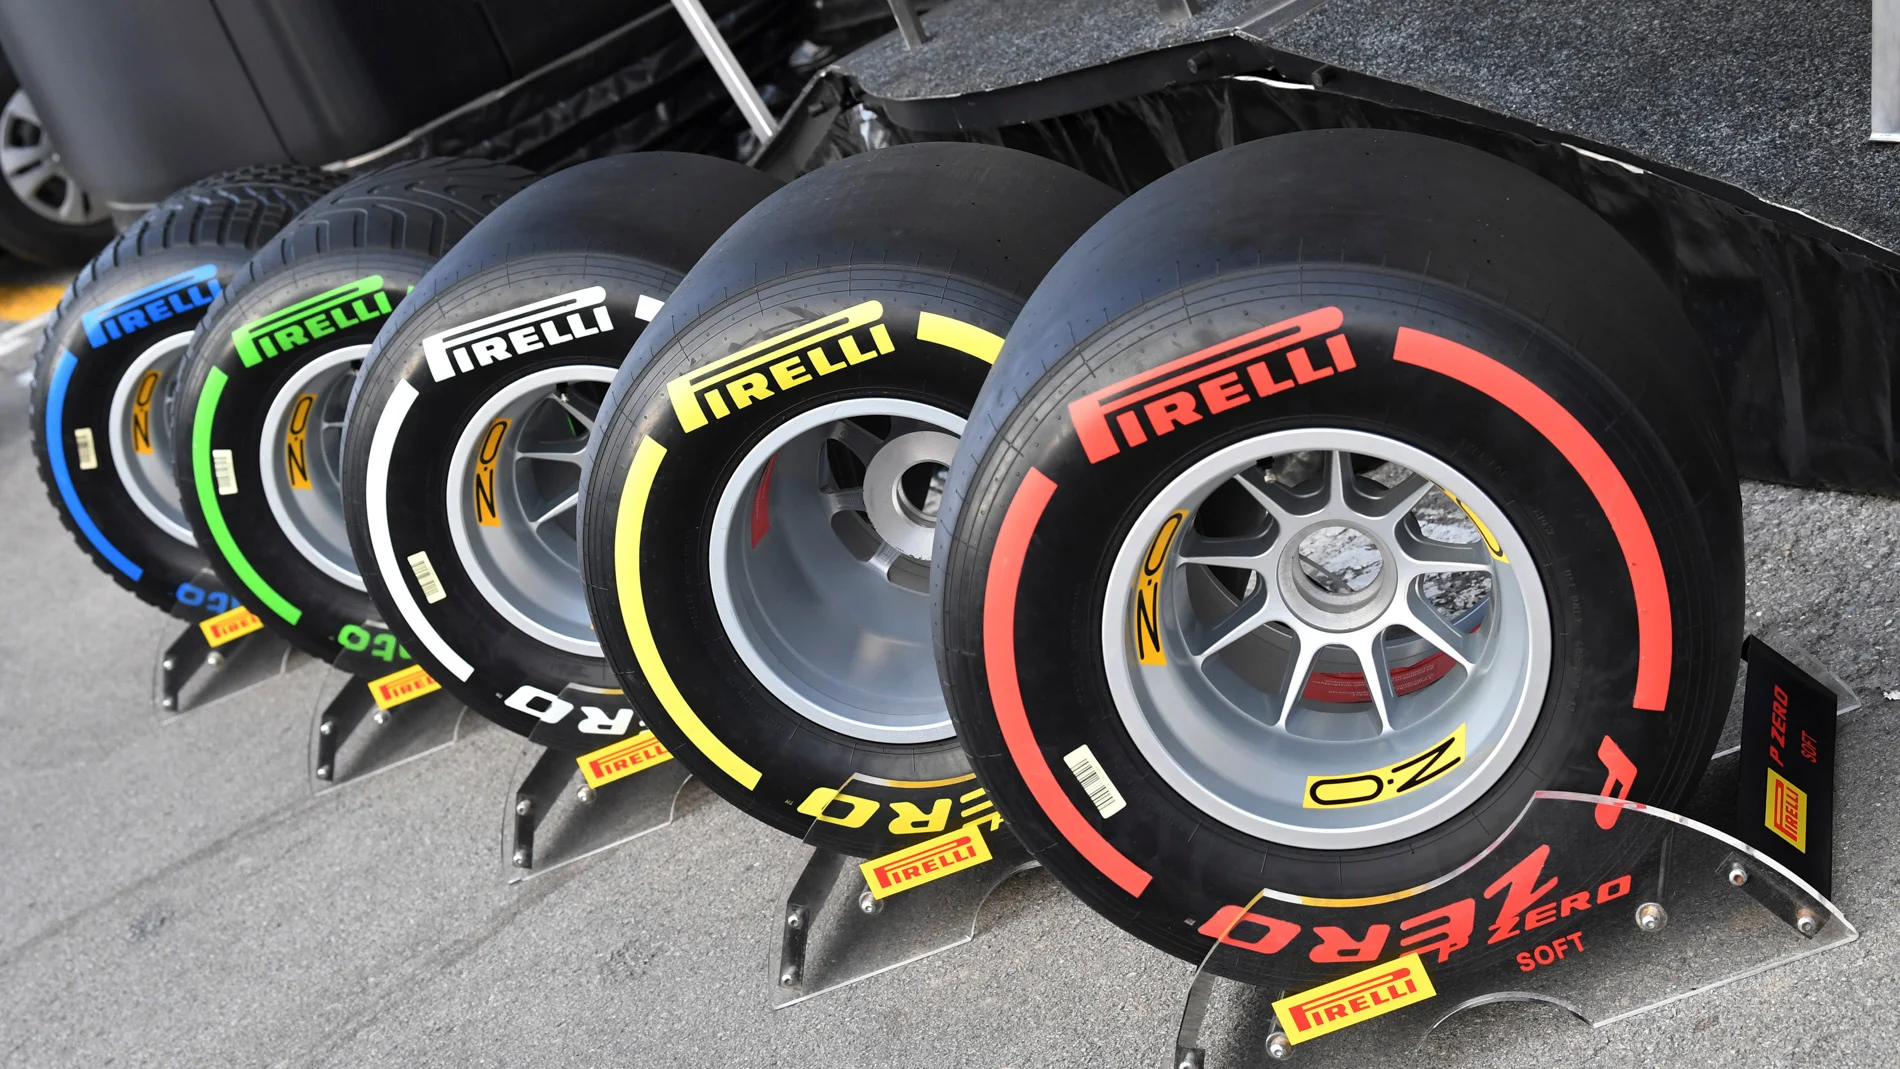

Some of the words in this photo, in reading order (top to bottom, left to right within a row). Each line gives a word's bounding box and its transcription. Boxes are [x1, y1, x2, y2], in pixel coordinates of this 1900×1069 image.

[82, 264, 222, 349] PIRELLI
[231, 275, 392, 368] PIRELLI
[422, 286, 614, 382] PIRELLI
[666, 300, 895, 433] PIRELLI
[1068, 306, 1357, 464] PIRELLI
[504, 685, 651, 735] RO
[1771, 684, 1788, 748] ZERO
[1770, 745, 1784, 767] P
[1801, 730, 1817, 763] SOFT
[1774, 778, 1799, 842] PIRELLI
[873, 836, 977, 888] PIRELLI
[1488, 875, 1632, 944] ZERO
[1516, 931, 1584, 972] SOFT
[1288, 967, 1418, 1032] PIRELLI
